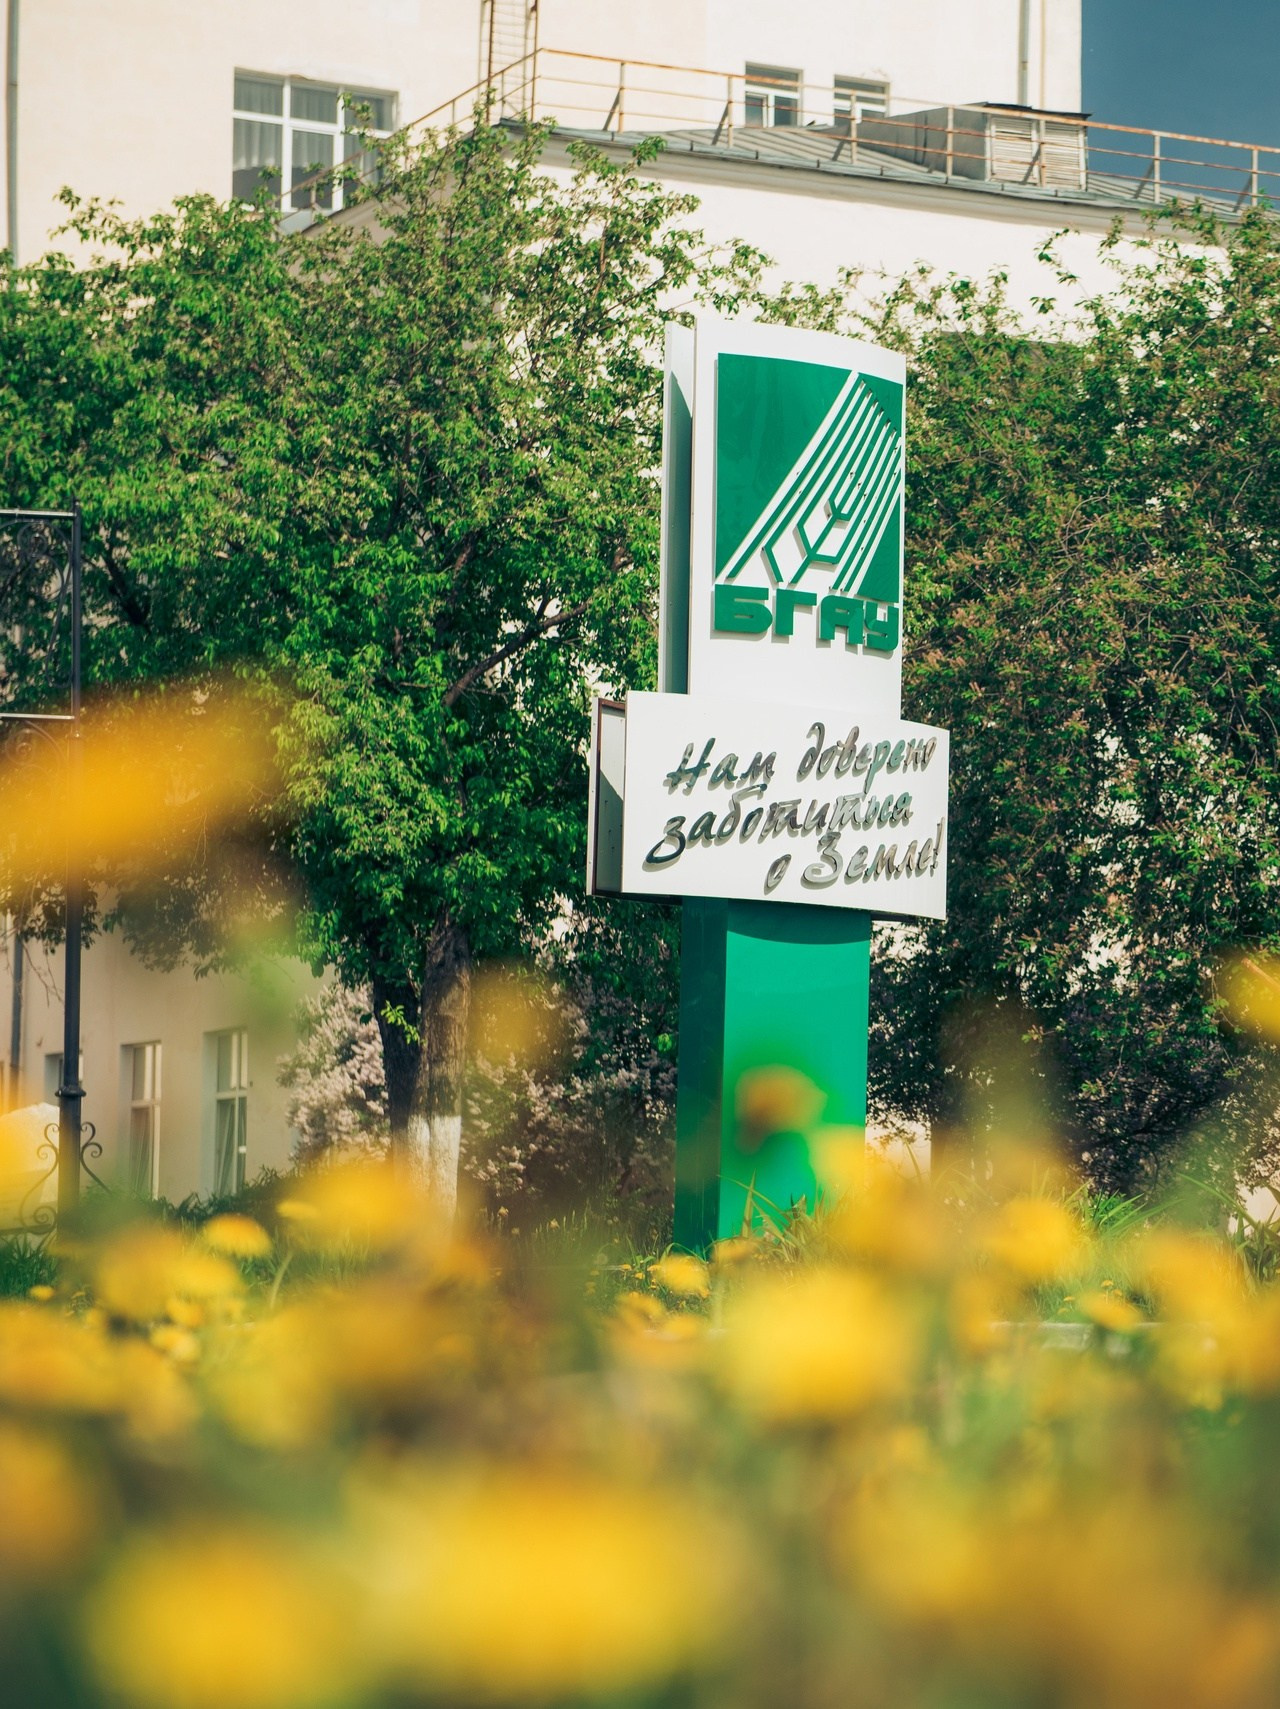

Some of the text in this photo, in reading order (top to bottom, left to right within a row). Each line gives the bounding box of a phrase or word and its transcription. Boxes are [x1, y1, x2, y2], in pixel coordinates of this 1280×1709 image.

[714, 583, 900, 652] БГАУ
[666, 721, 937, 794] Нам доверено
[645, 783, 914, 865] заботиться
[764, 816, 946, 891] о Земле!
